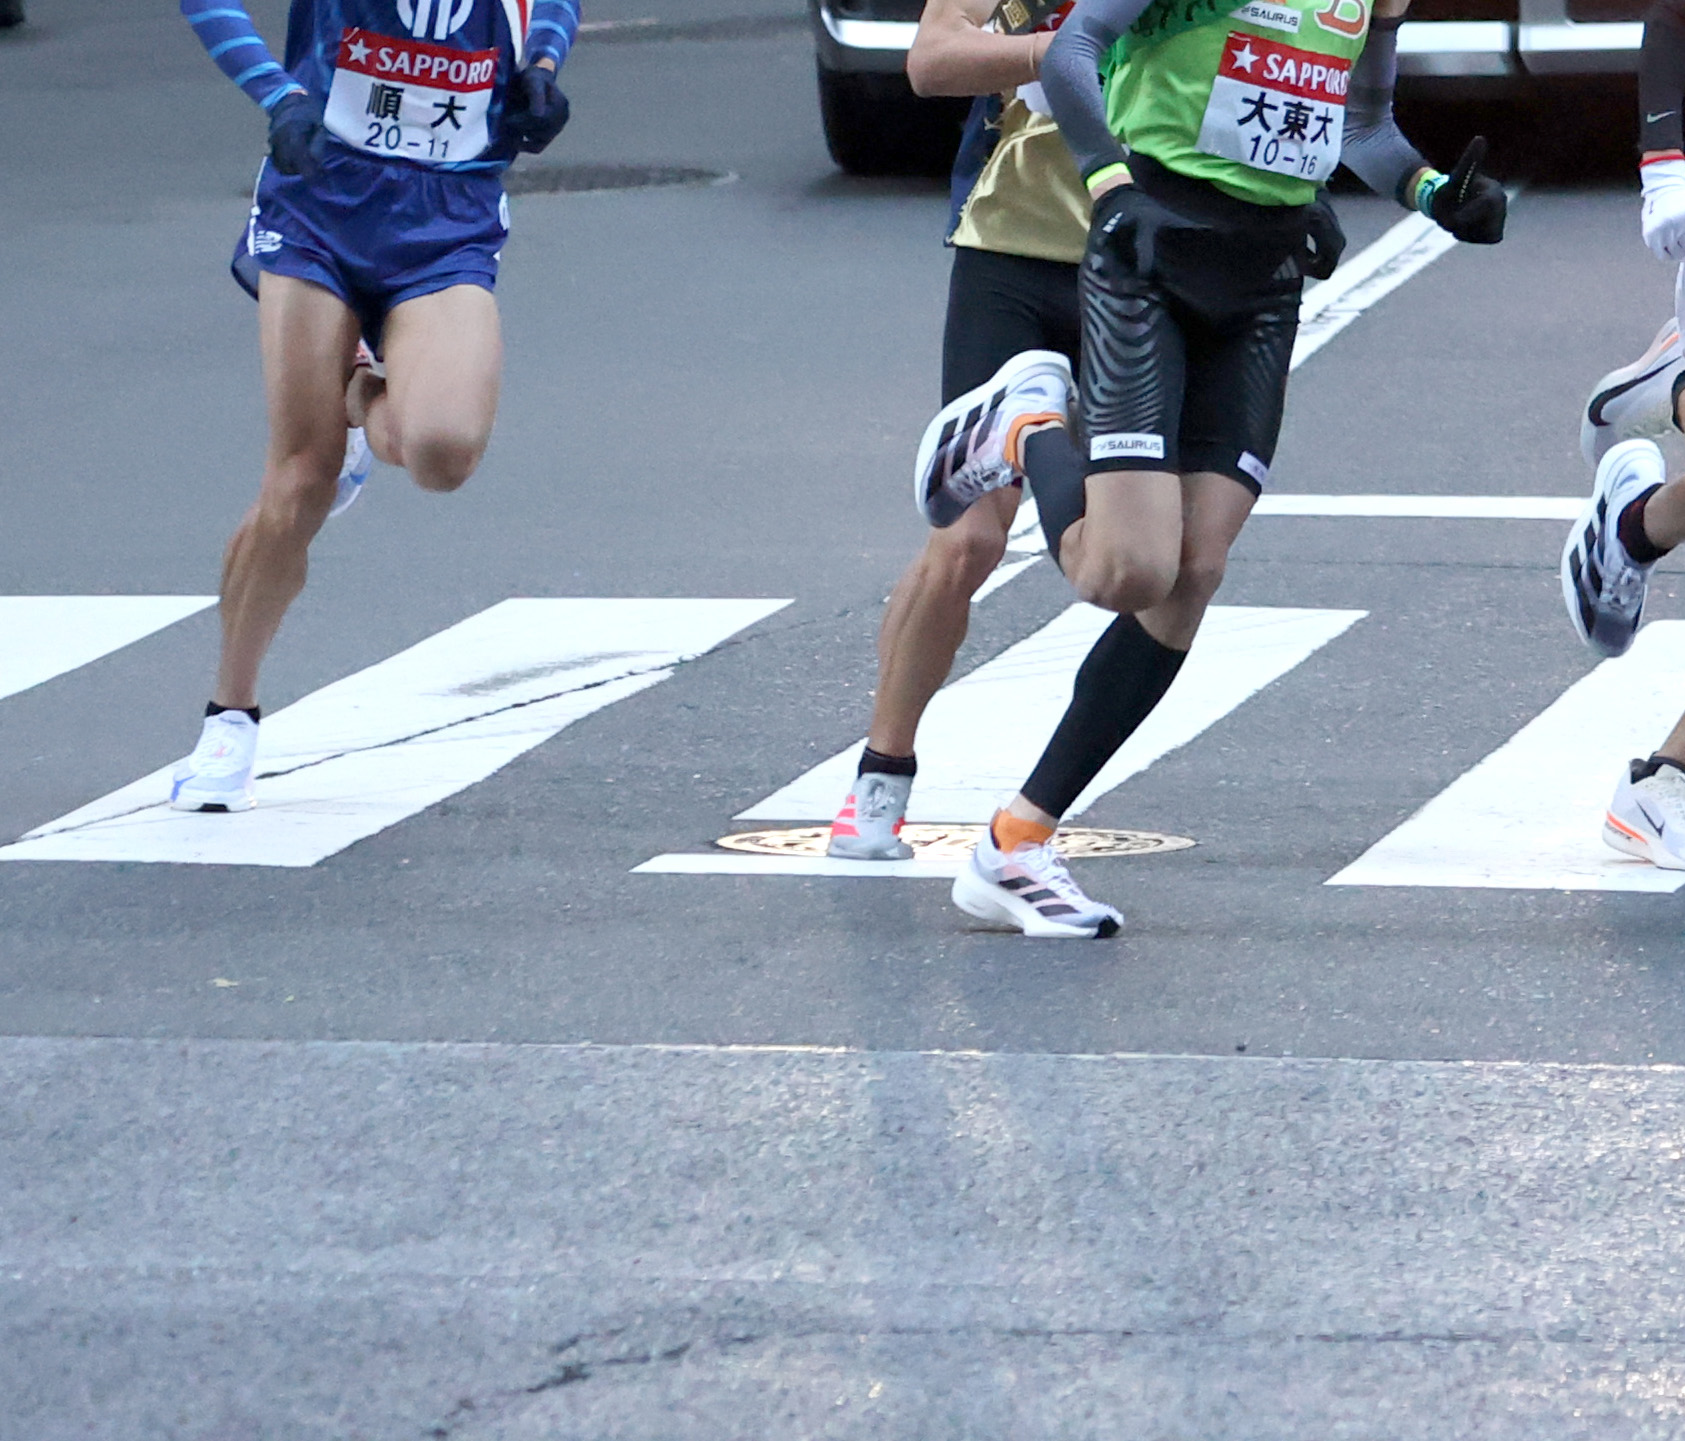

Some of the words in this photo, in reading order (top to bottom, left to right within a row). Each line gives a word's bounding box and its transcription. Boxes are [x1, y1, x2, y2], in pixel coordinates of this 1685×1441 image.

[375, 47, 494, 86] SAPPORO
[1236, 91, 1334, 146] 大東大
[364, 122, 450, 159] 20-11
[1250, 134, 1317, 174] 10-16
